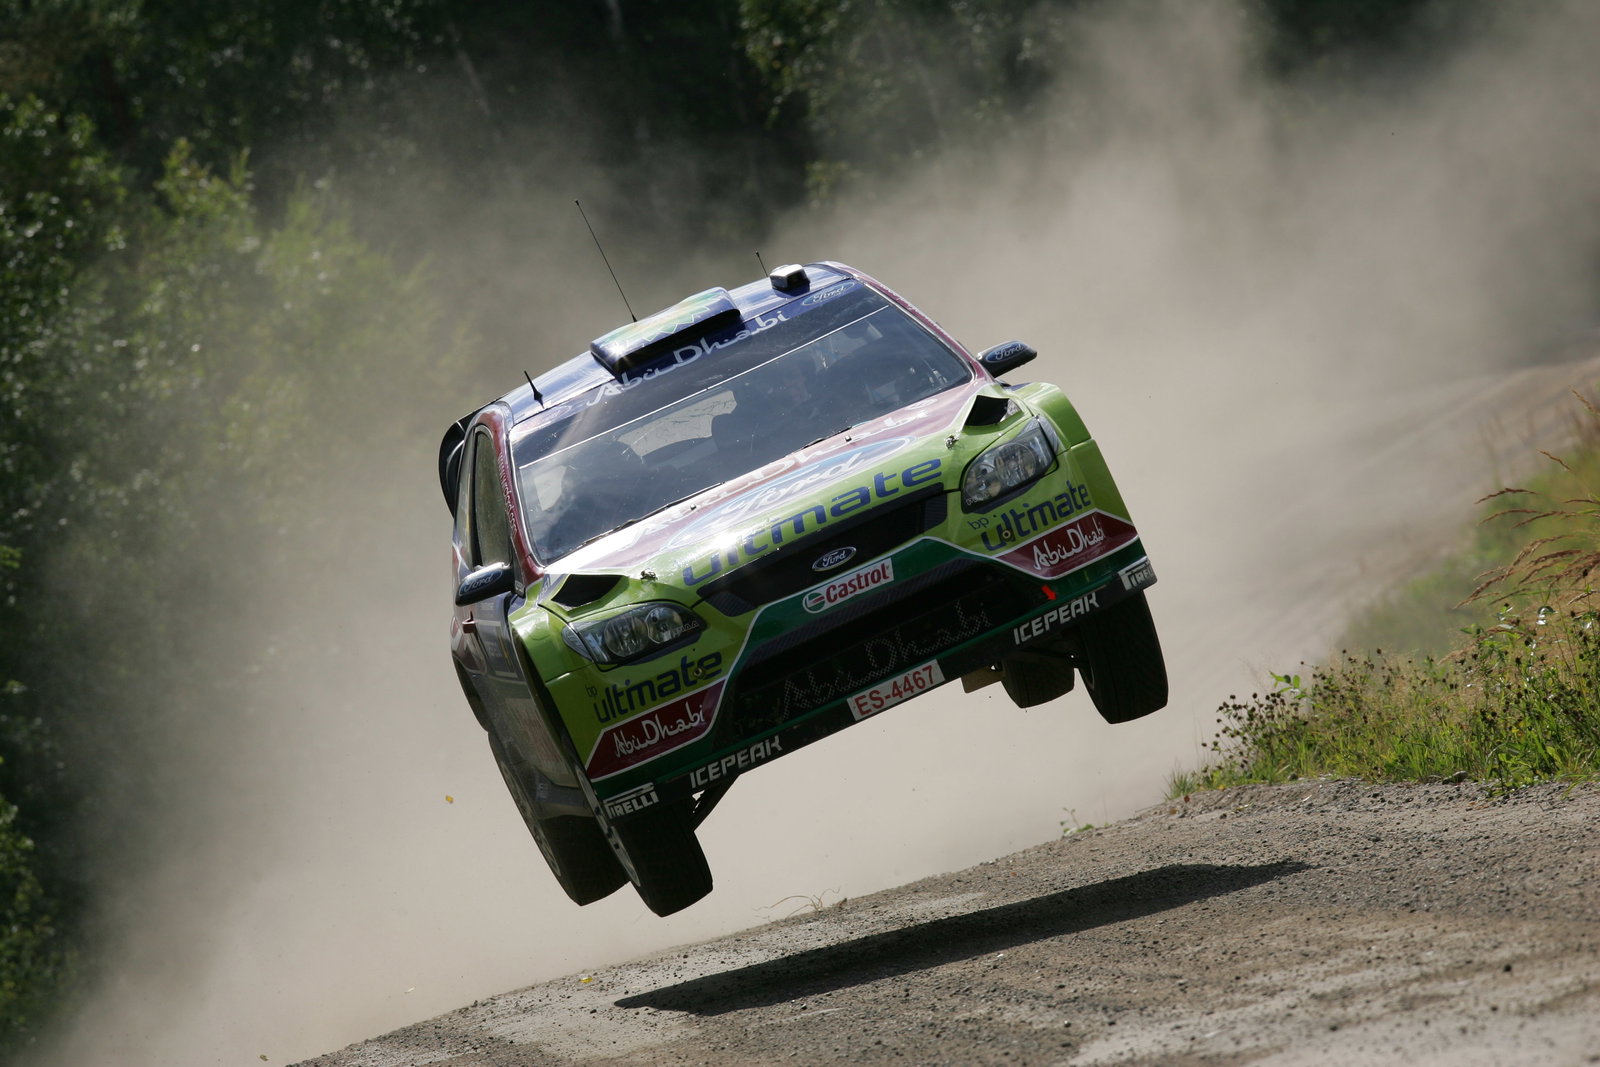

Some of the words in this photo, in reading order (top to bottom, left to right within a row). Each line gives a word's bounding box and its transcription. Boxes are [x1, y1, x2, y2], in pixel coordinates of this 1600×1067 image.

[811, 284, 848, 301] Ford
[586, 366, 676, 406] Abu
[673, 310, 790, 366] Dhabi
[995, 342, 1024, 361] Ford
[967, 516, 989, 531] bp
[980, 479, 1092, 551] ultimate
[821, 549, 849, 568] Ford
[1032, 540, 1072, 571] Abu
[464, 573, 494, 592] Ford
[824, 562, 890, 605] Castrol
[1012, 591, 1100, 645] ICEPEAK
[585, 683, 598, 698] bp
[593, 651, 723, 723] ultimate
[854, 664, 936, 717] ES-4467
[612, 729, 651, 759] Abu
[641, 701, 706, 746] Dhabi
[689, 734, 784, 789] ICEPEAK
[602, 782, 660, 820] PIRELLI
